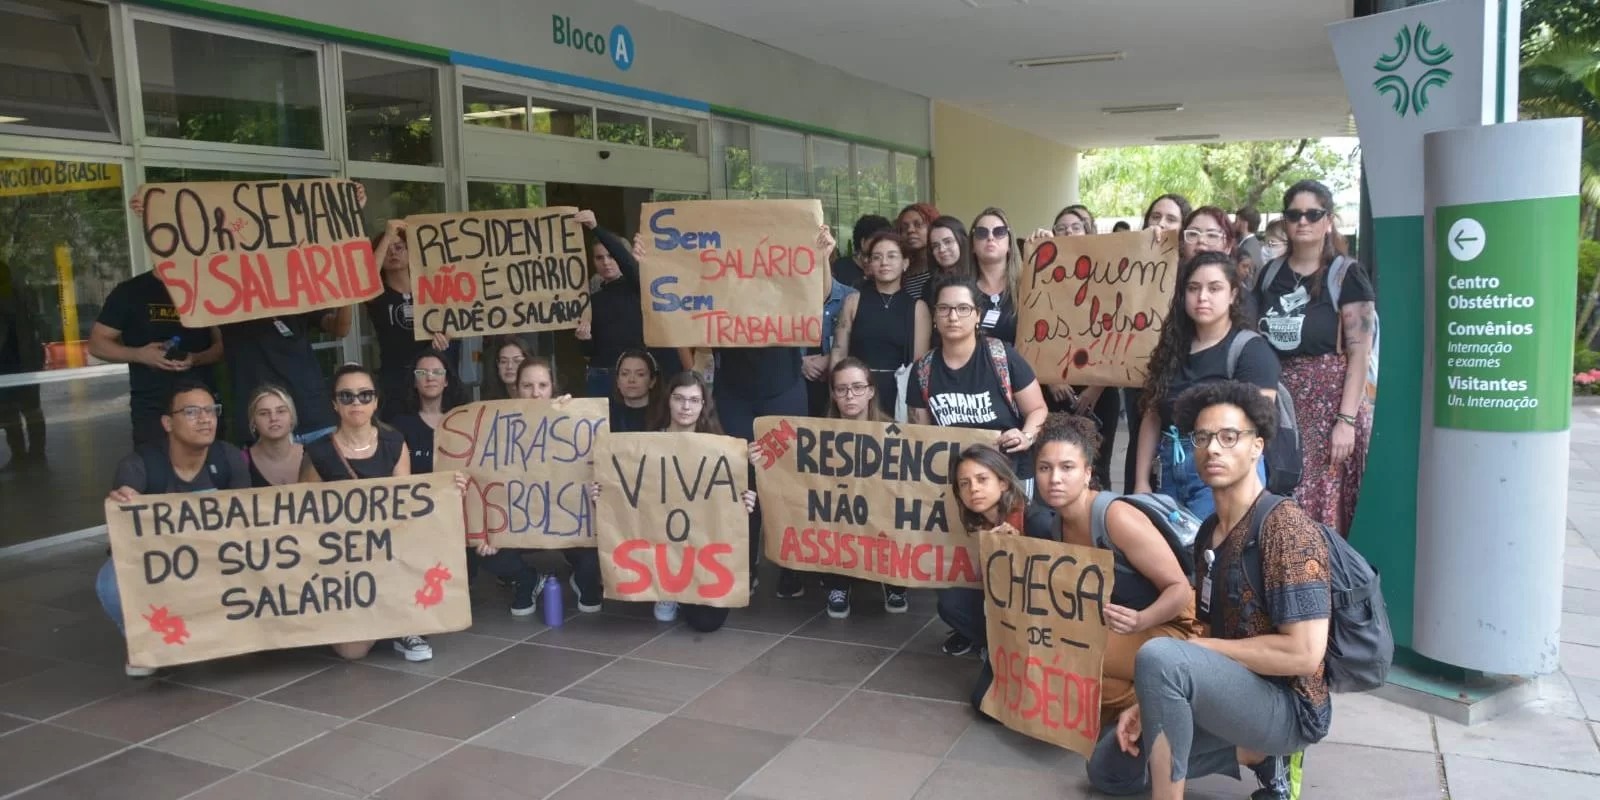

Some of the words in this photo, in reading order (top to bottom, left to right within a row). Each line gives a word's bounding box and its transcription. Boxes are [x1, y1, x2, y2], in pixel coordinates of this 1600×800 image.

[552, 14, 606, 56] Bloco
[615, 33, 629, 63] A
[0, 167, 28, 189] NCO
[31, 166, 52, 186] DO
[55, 160, 111, 184] BRASIL
[143, 187, 236, 258] 60h
[232, 182, 365, 251] SEMANA
[416, 214, 582, 267] RESIDENTE
[649, 208, 721, 250] Sem
[157, 259, 198, 316] S/
[203, 238, 381, 316] SALÁRIO
[418, 264, 477, 305] NÃO
[481, 262, 503, 301] É
[506, 256, 585, 296] OTÁRIO
[700, 234, 816, 281] SALÁRIO
[1028, 241, 1168, 307] Paguem
[650, 276, 714, 312] Sem
[1448, 275, 1500, 290] Centro
[1448, 293, 1535, 310] Obstétrico
[422, 302, 484, 335] CADÊ
[487, 306, 507, 330] O
[512, 292, 590, 328] SALÁRIO?
[691, 310, 822, 345] TRABALHO
[1024, 314, 1071, 343] as
[1078, 291, 1164, 338] bolsas
[1447, 320, 1534, 336] Convênios
[1447, 341, 1513, 357] Internação
[1447, 358, 1455, 368] e
[1455, 358, 1501, 369] exames
[929, 390, 993, 411] LEVANTE
[1447, 376, 1528, 392] Visitantes
[1448, 394, 1466, 407] Un.
[1467, 395, 1539, 412] Internação
[937, 406, 978, 417] POPULAR
[938, 411, 998, 428] JUVENTUDE
[438, 405, 486, 468] S/
[757, 419, 798, 471] SEM
[796, 424, 961, 485] RESIDÊNCI
[612, 454, 738, 509] VIVA
[119, 483, 435, 538] TRABALHADORES
[507, 479, 597, 538] BOLSA
[665, 508, 691, 543] O
[808, 484, 869, 525] NÃO
[894, 492, 949, 533] HÁ
[143, 545, 199, 585] DO
[218, 534, 301, 576] SUS
[318, 528, 393, 566] SEM
[612, 538, 736, 599] SUS
[780, 526, 978, 583] ASSISTÊNCIA
[221, 571, 377, 621] SALÁRIO
[986, 550, 1106, 626] CHEGA
[1026, 627, 1053, 648] DE
